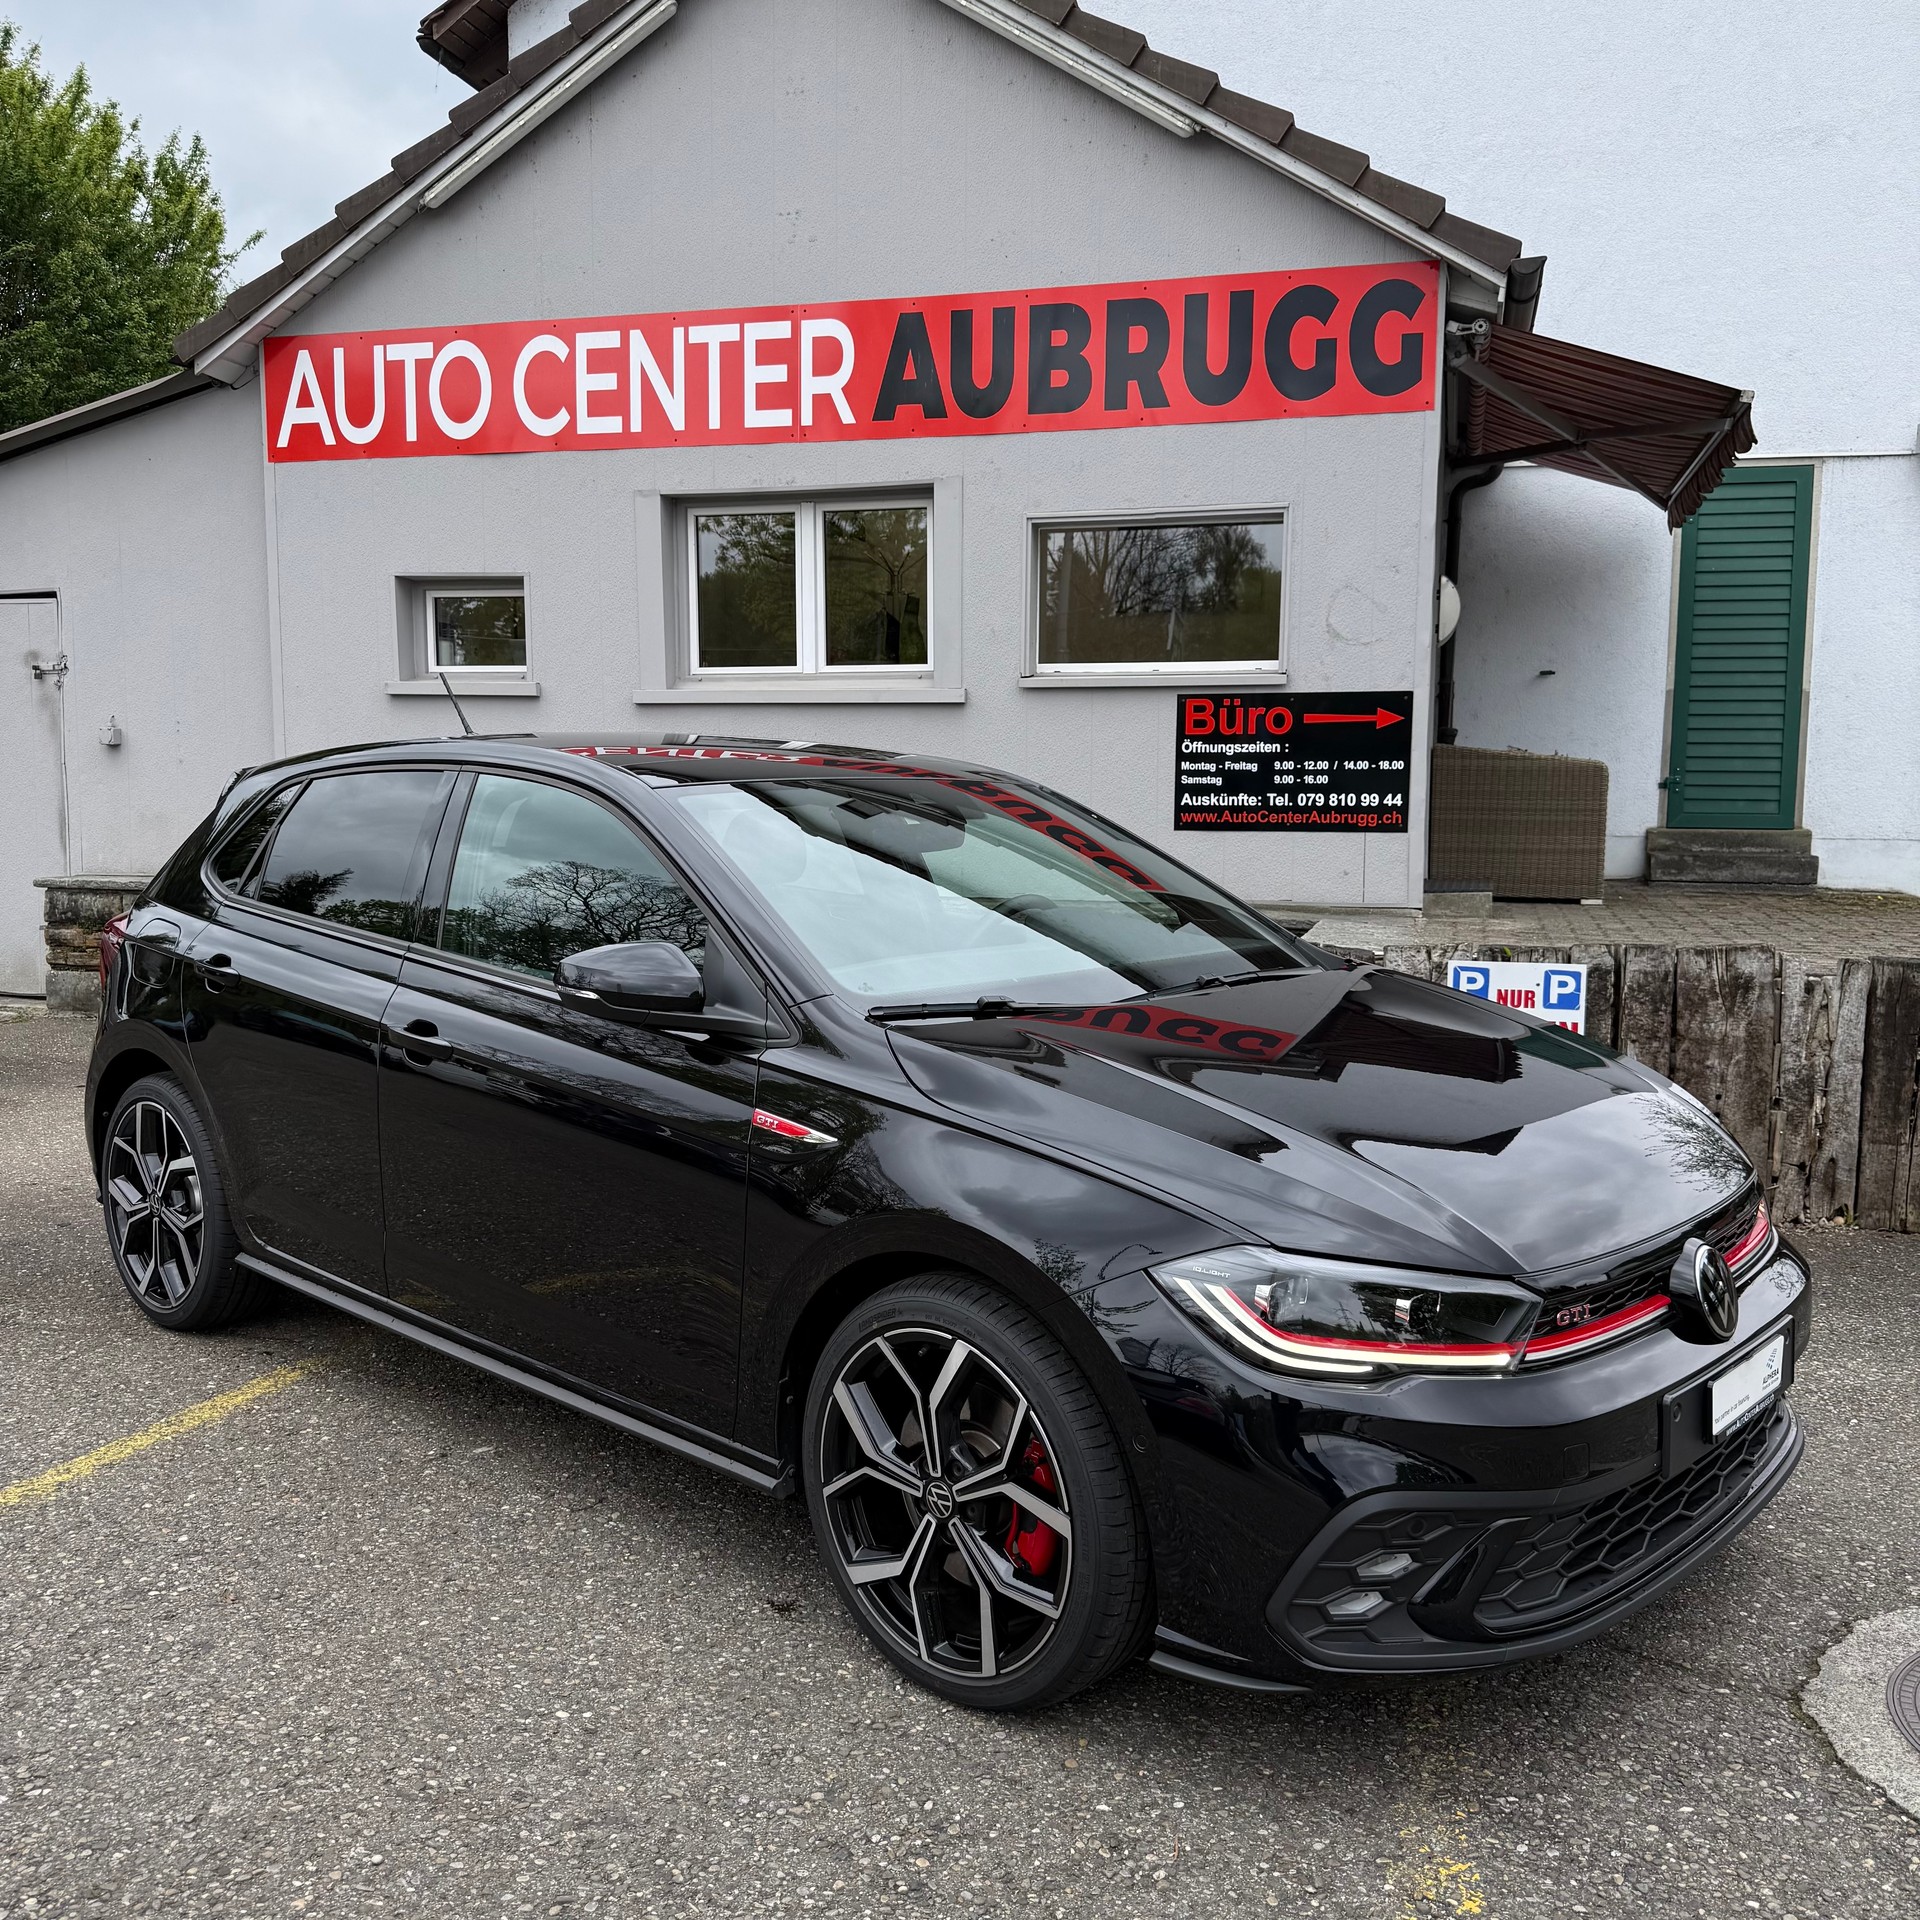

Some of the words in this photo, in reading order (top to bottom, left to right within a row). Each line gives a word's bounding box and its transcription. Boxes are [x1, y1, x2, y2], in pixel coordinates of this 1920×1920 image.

[277, 340, 492, 449] AUTO
[513, 318, 857, 438] CENTER
[872, 278, 1427, 421] AUBRUGG
[1185, 698, 1293, 735] Büro
[1181, 738, 1281, 756] Öffnungszeiten
[1181, 761, 1217, 772] Montag
[1225, 761, 1258, 772] Freitag
[1273, 760, 1294, 770] 9.00
[1303, 760, 1329, 770] 12.00
[1343, 760, 1369, 770] 14.00
[1378, 760, 1404, 770] 18.00
[1181, 775, 1222, 786] Samstag
[1273, 775, 1294, 784] 9.00
[1303, 775, 1329, 784] 16.00
[1180, 792, 1262, 806] Auskünfte:
[1266, 792, 1293, 806] Tel.
[1297, 793, 1324, 806] 079
[1329, 793, 1356, 806] 810
[1360, 793, 1379, 806] 99
[1383, 793, 1403, 806] 44
[1180, 810, 1402, 827] www.AutoCenterAubrugg.ch
[1496, 988, 1536, 1009] NUR
[756, 1115, 779, 1129] GTI
[1556, 1303, 1591, 1327] GTI
